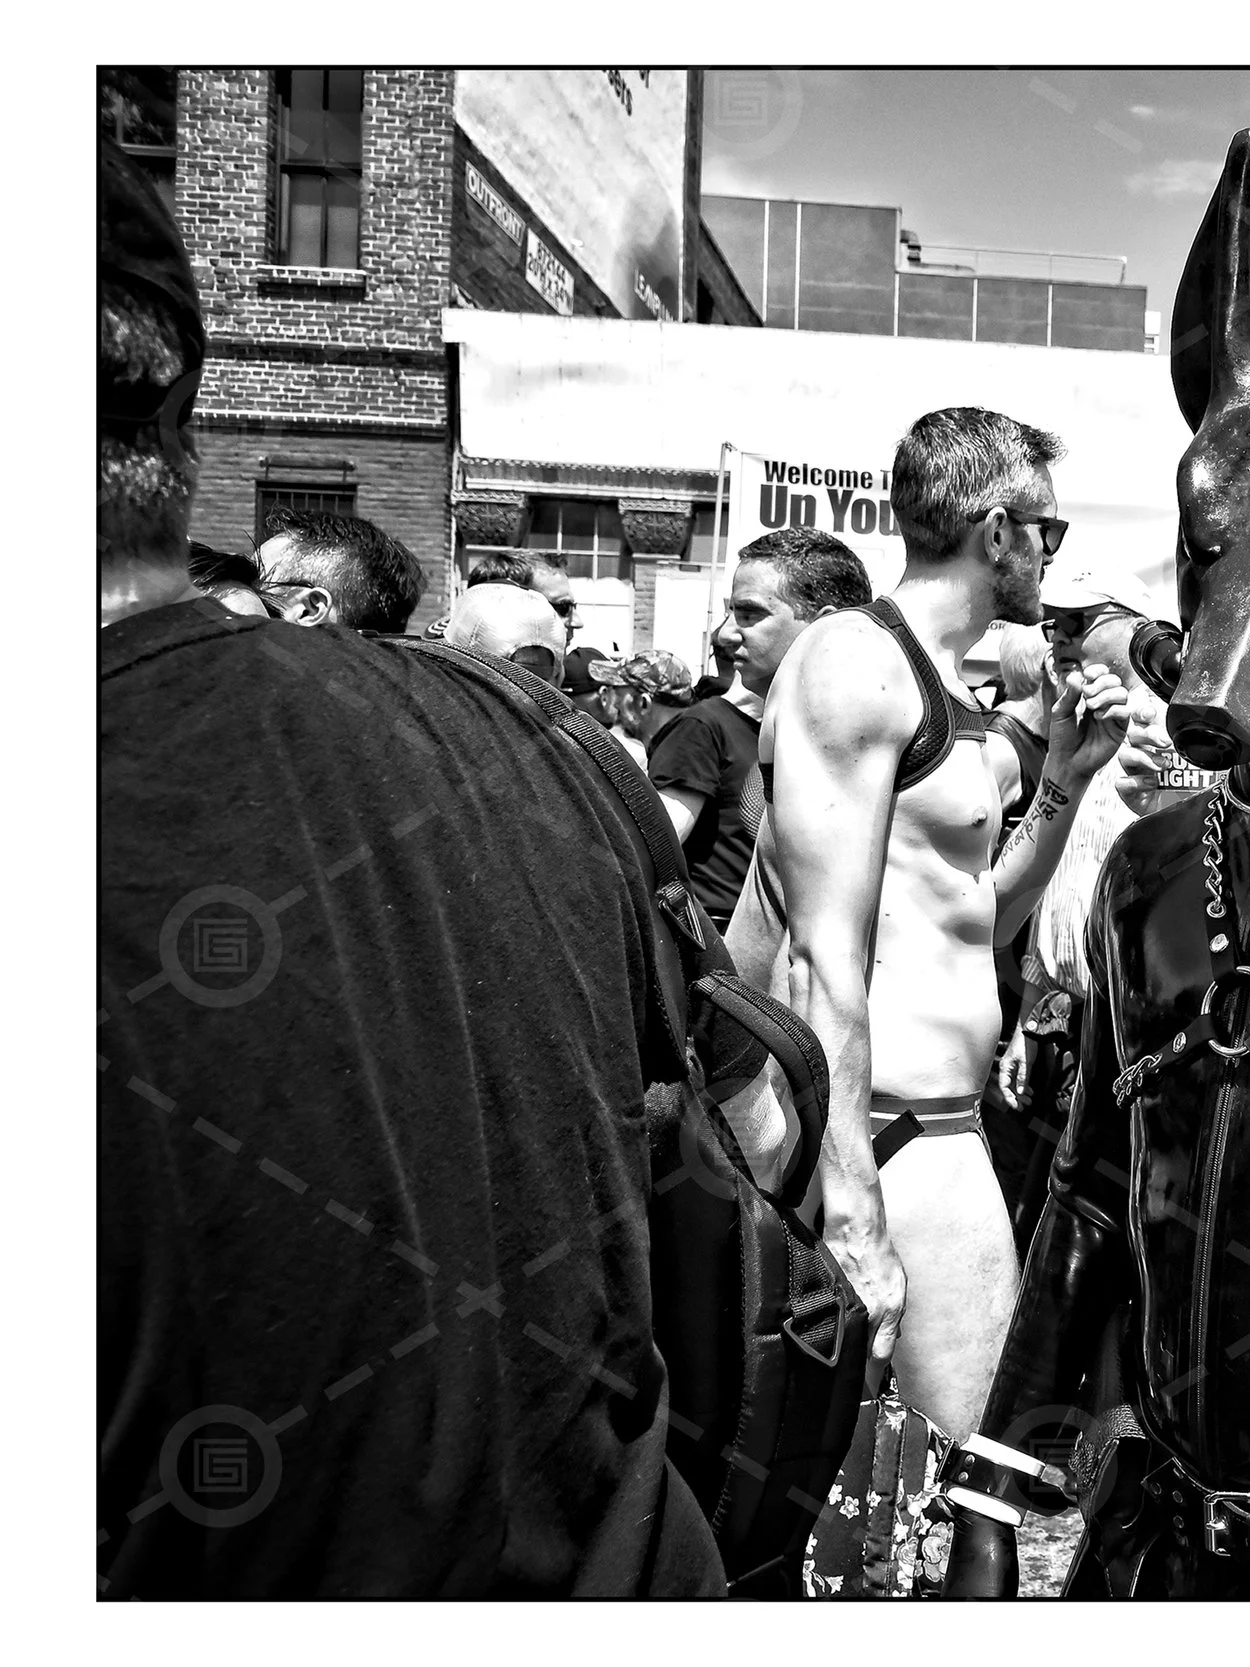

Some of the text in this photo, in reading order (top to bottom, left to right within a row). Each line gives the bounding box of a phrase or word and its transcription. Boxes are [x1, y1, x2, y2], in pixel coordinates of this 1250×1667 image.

[467, 168, 523, 240] OUTFRONT
[763, 460, 874, 490] Welcome
[759, 483, 817, 530] Up
[1156, 769, 1214, 788] LIGHT
